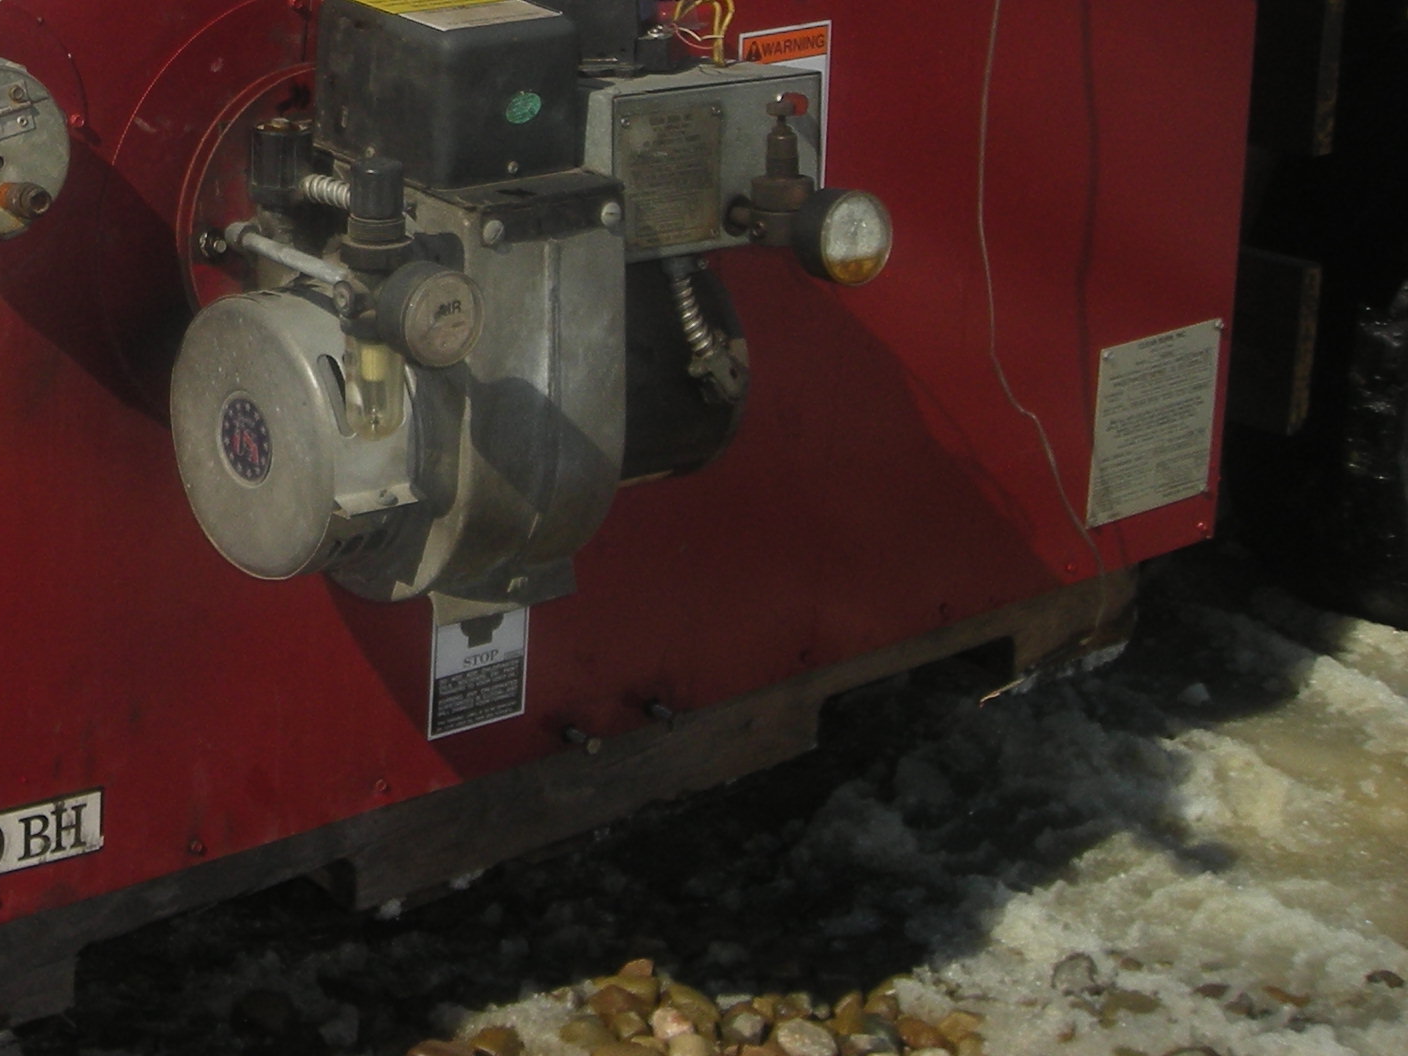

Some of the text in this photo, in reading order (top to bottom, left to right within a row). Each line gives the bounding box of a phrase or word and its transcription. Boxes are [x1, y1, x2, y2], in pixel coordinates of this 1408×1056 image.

[761, 34, 824, 57] WARNING
[464, 649, 499, 668] STOP
[18, 803, 87, 861] BH
